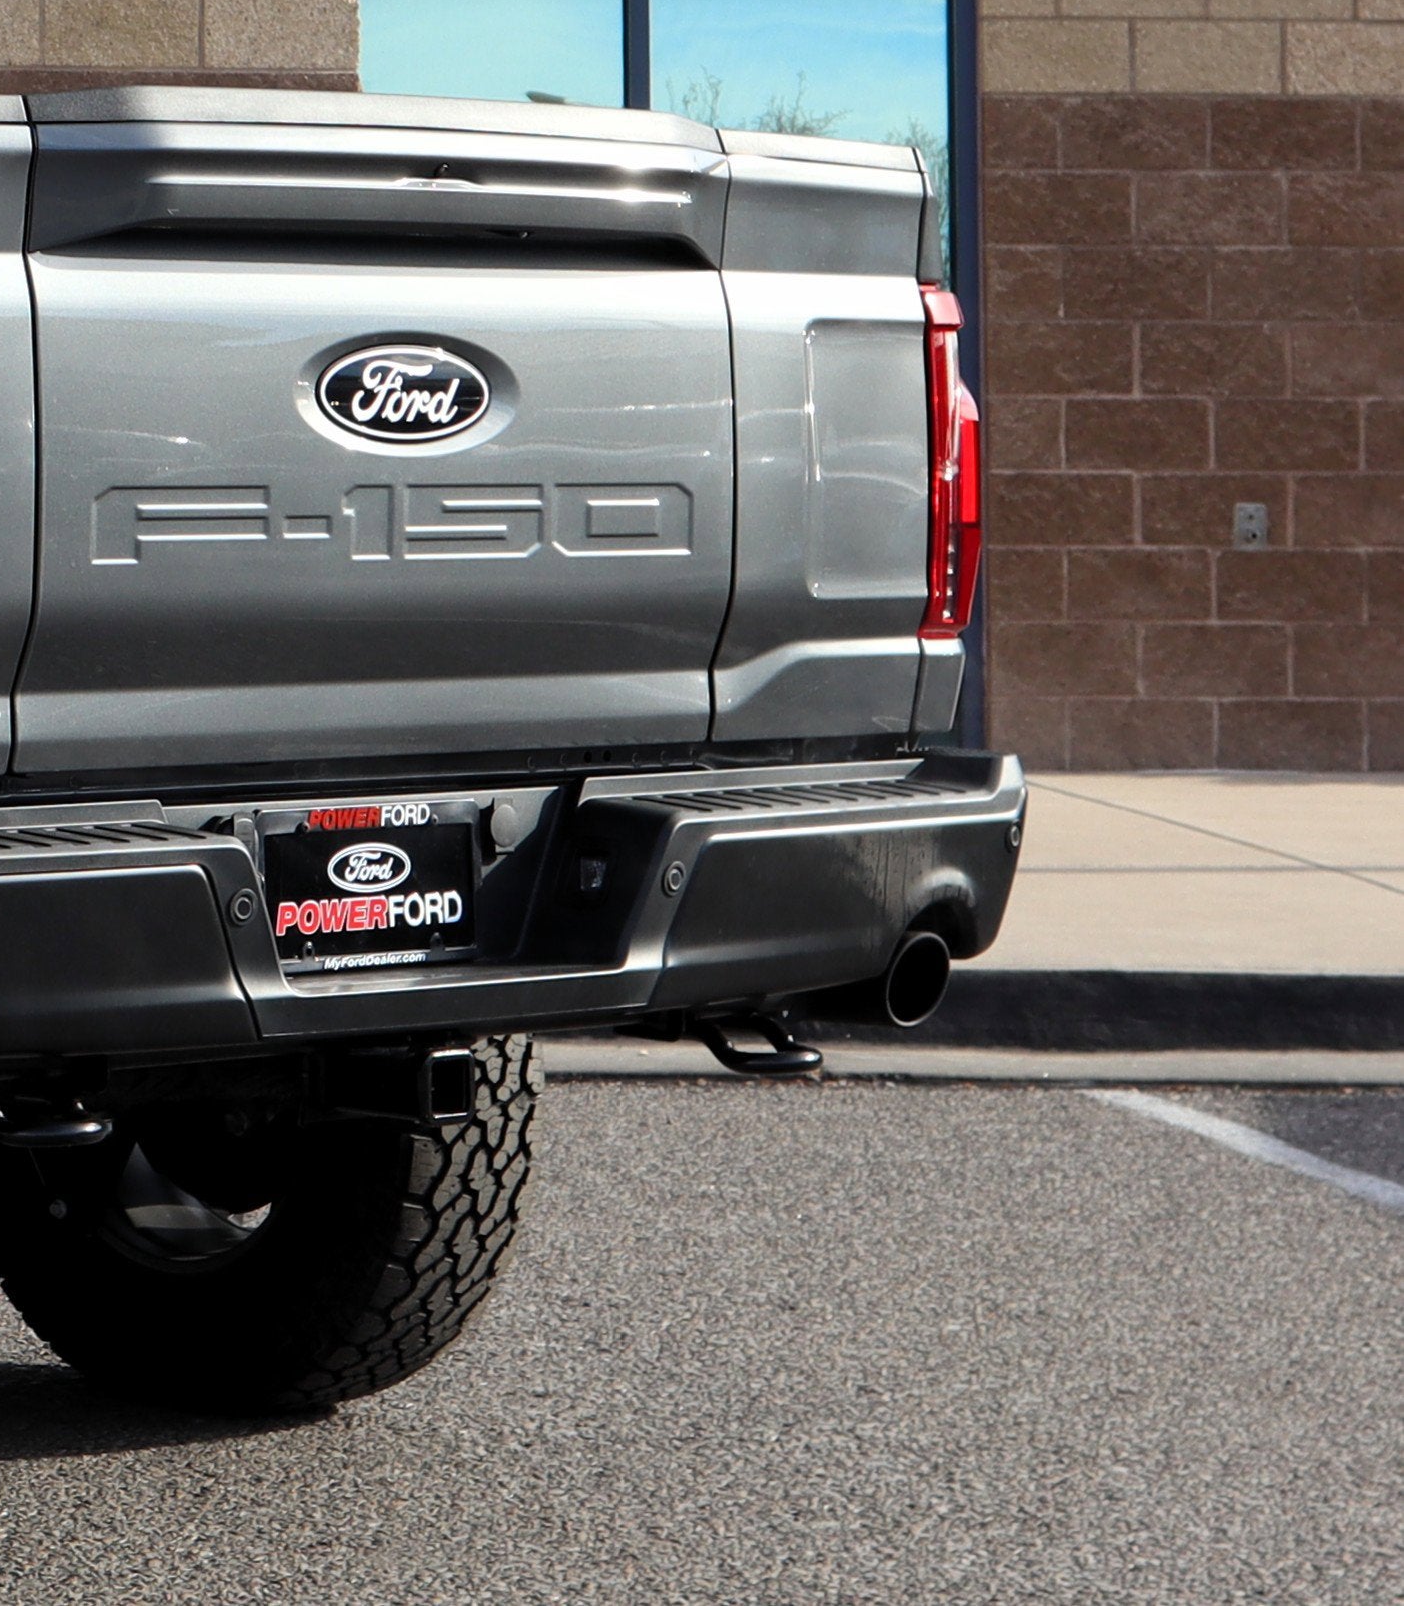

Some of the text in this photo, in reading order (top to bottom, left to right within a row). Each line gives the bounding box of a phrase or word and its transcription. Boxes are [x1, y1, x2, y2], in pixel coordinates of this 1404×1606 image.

[351, 360, 460, 424] Ford
[91, 483, 692, 564] F-150
[345, 852, 393, 881] Ford
[324, 952, 426, 971] MyFordDealer.com
